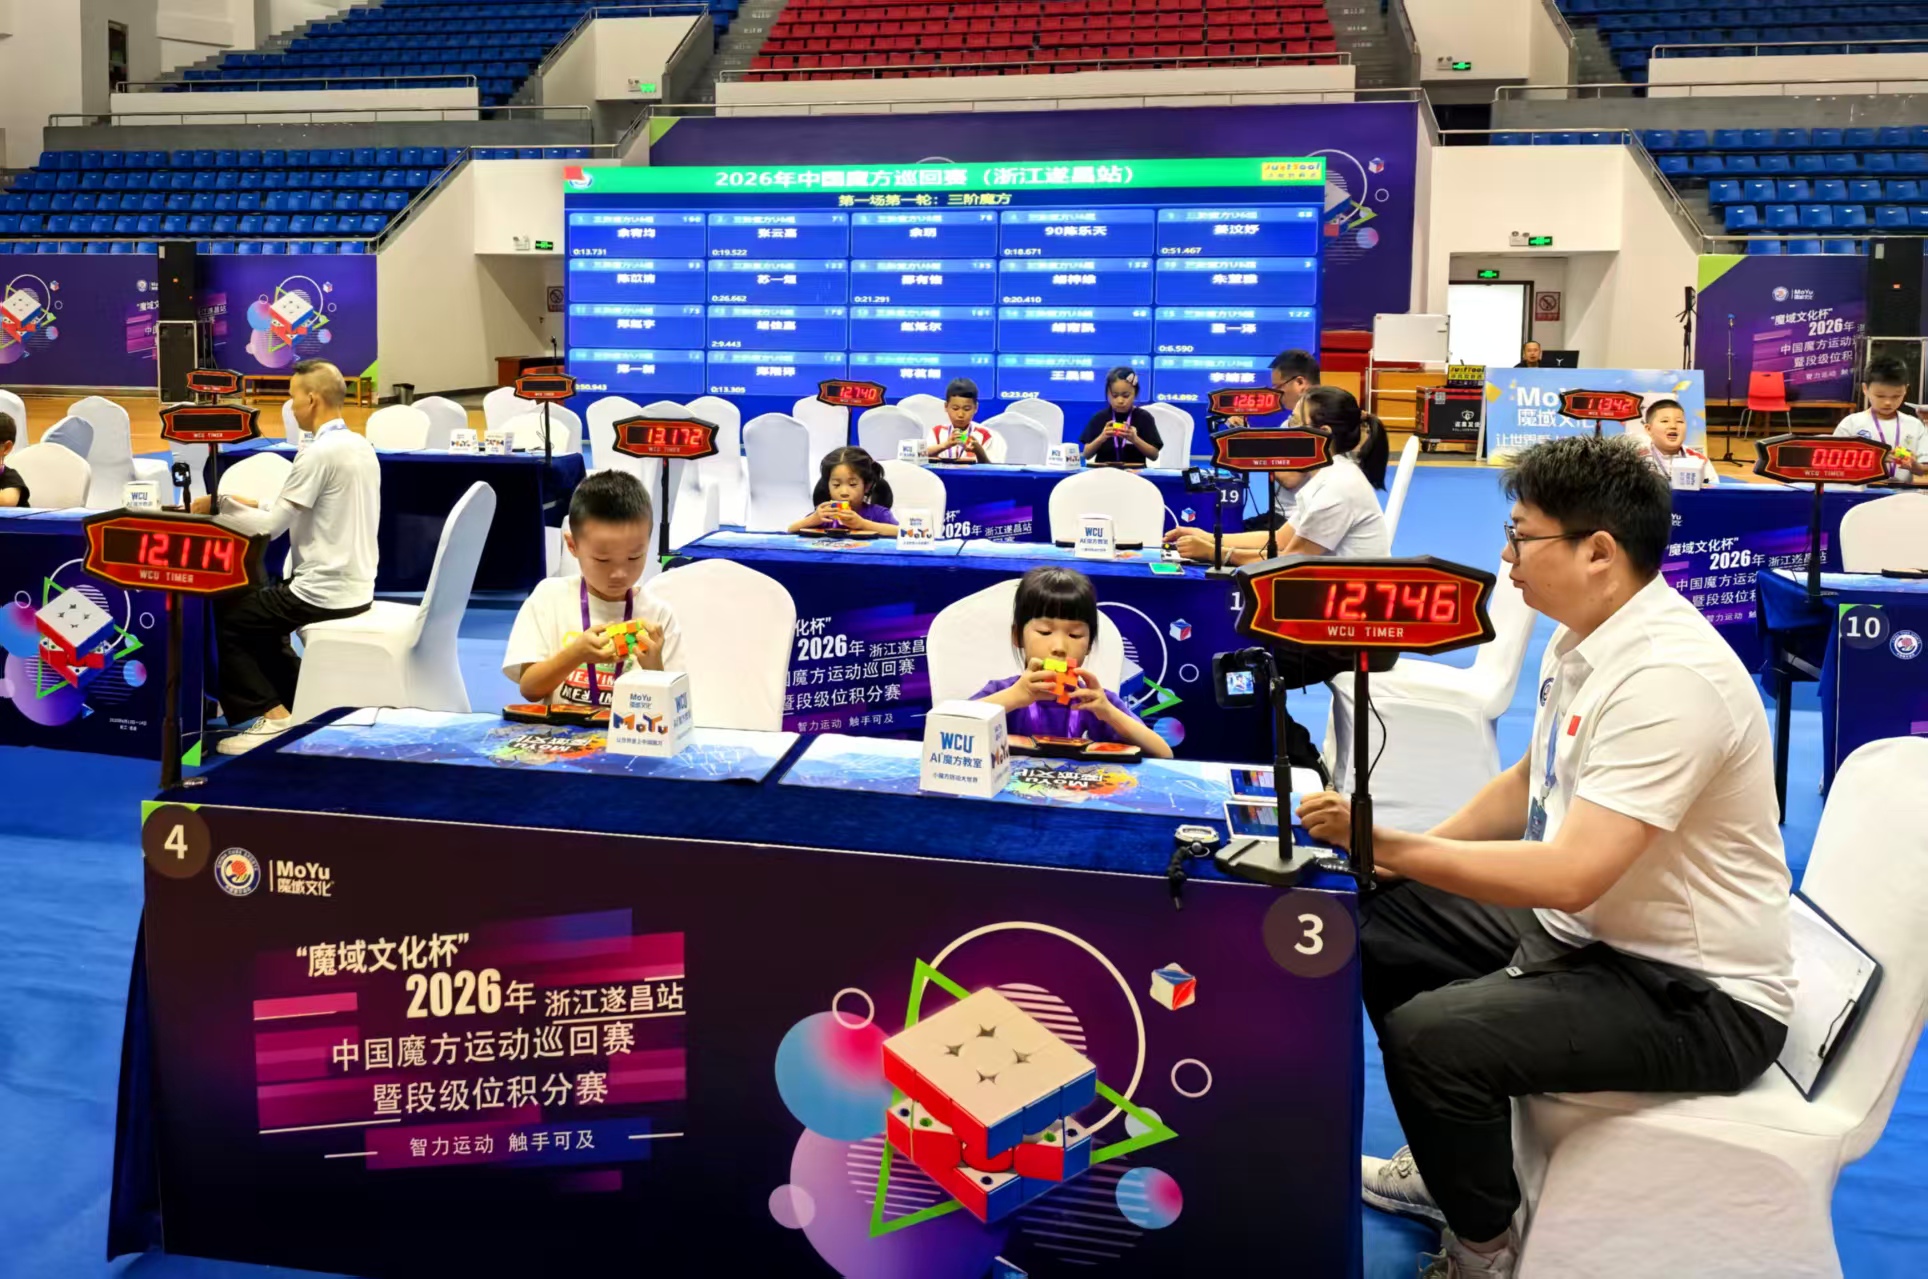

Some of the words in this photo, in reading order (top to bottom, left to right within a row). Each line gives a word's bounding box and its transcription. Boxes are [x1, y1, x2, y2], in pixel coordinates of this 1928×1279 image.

[1808, 318, 1855, 336] 2026年
[1220, 490, 1239, 503] 19
[1084, 527, 1104, 537] WCU
[1709, 550, 1765, 570] 2026年
[140, 570, 160, 580] WCU
[165, 571, 194, 583] TIMER
[1325, 583, 1457, 622] 12.746
[1328, 626, 1355, 637] WCU
[1364, 626, 1404, 638] TIMER
[1846, 616, 1881, 639] 10
[797, 634, 865, 661] 2026年
[869, 639, 926, 657] 浙江遂昌
[785, 658, 915, 687] 魔方运动巡回赛
[630, 693, 652, 701] MoYu
[613, 712, 668, 735] MoYu
[797, 719, 842, 733] 智力运动
[849, 713, 894, 727] 触手可及
[940, 731, 975, 754] WCU
[164, 824, 188, 859] 4
[277, 861, 330, 880] MoYu
[277, 878, 332, 897] 魔域文化
[1294, 913, 1324, 955] 3
[296, 932, 470, 977] “魔域文化杯”
[406, 968, 536, 1018] 2026年
[544, 982, 684, 1018] 浙江遂昌站
[332, 1022, 635, 1072] 中国魔方运动巡回赛
[373, 1071, 608, 1116] 暨段级位积分赛
[410, 1135, 494, 1157] 智力运动
[508, 1129, 595, 1151] 触手可及
